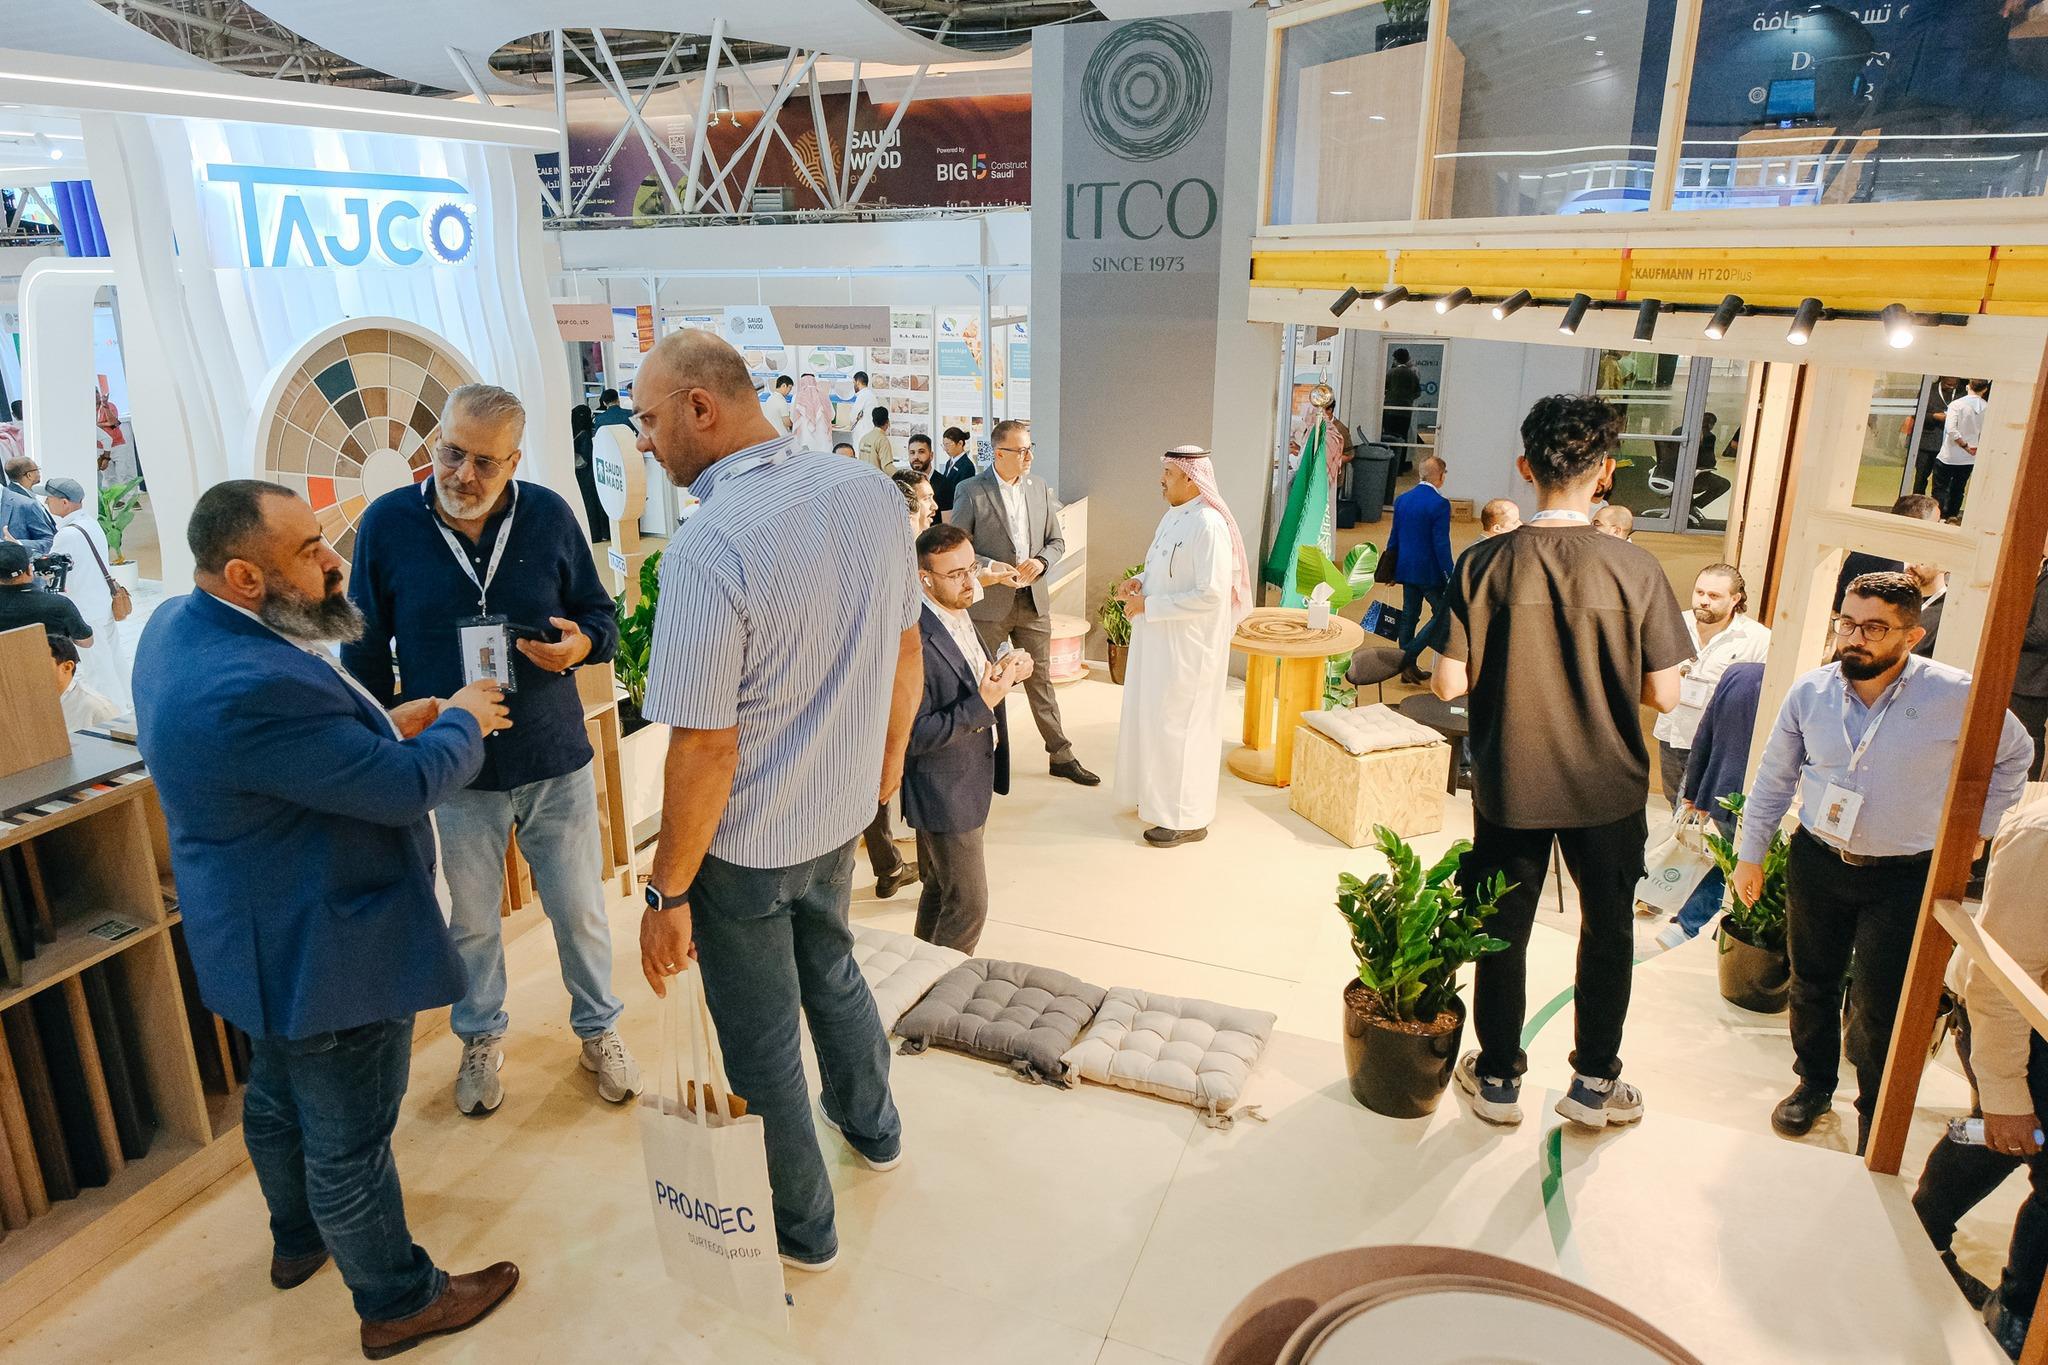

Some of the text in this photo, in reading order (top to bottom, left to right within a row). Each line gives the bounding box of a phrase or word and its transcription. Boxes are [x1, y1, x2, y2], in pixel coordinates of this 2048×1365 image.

[937, 162, 968, 182] BIG
[991, 160, 1028, 170] Construct
[991, 168, 1014, 179] Saudi
[206, 163, 473, 268] TAJCO
[1065, 178, 1218, 240] ITCO
[1092, 256, 1185, 272] SINCE 1973
[604, 461, 623, 478] SAUDI
[606, 476, 624, 492] MADE
[655, 1180, 756, 1234] PROADEC
